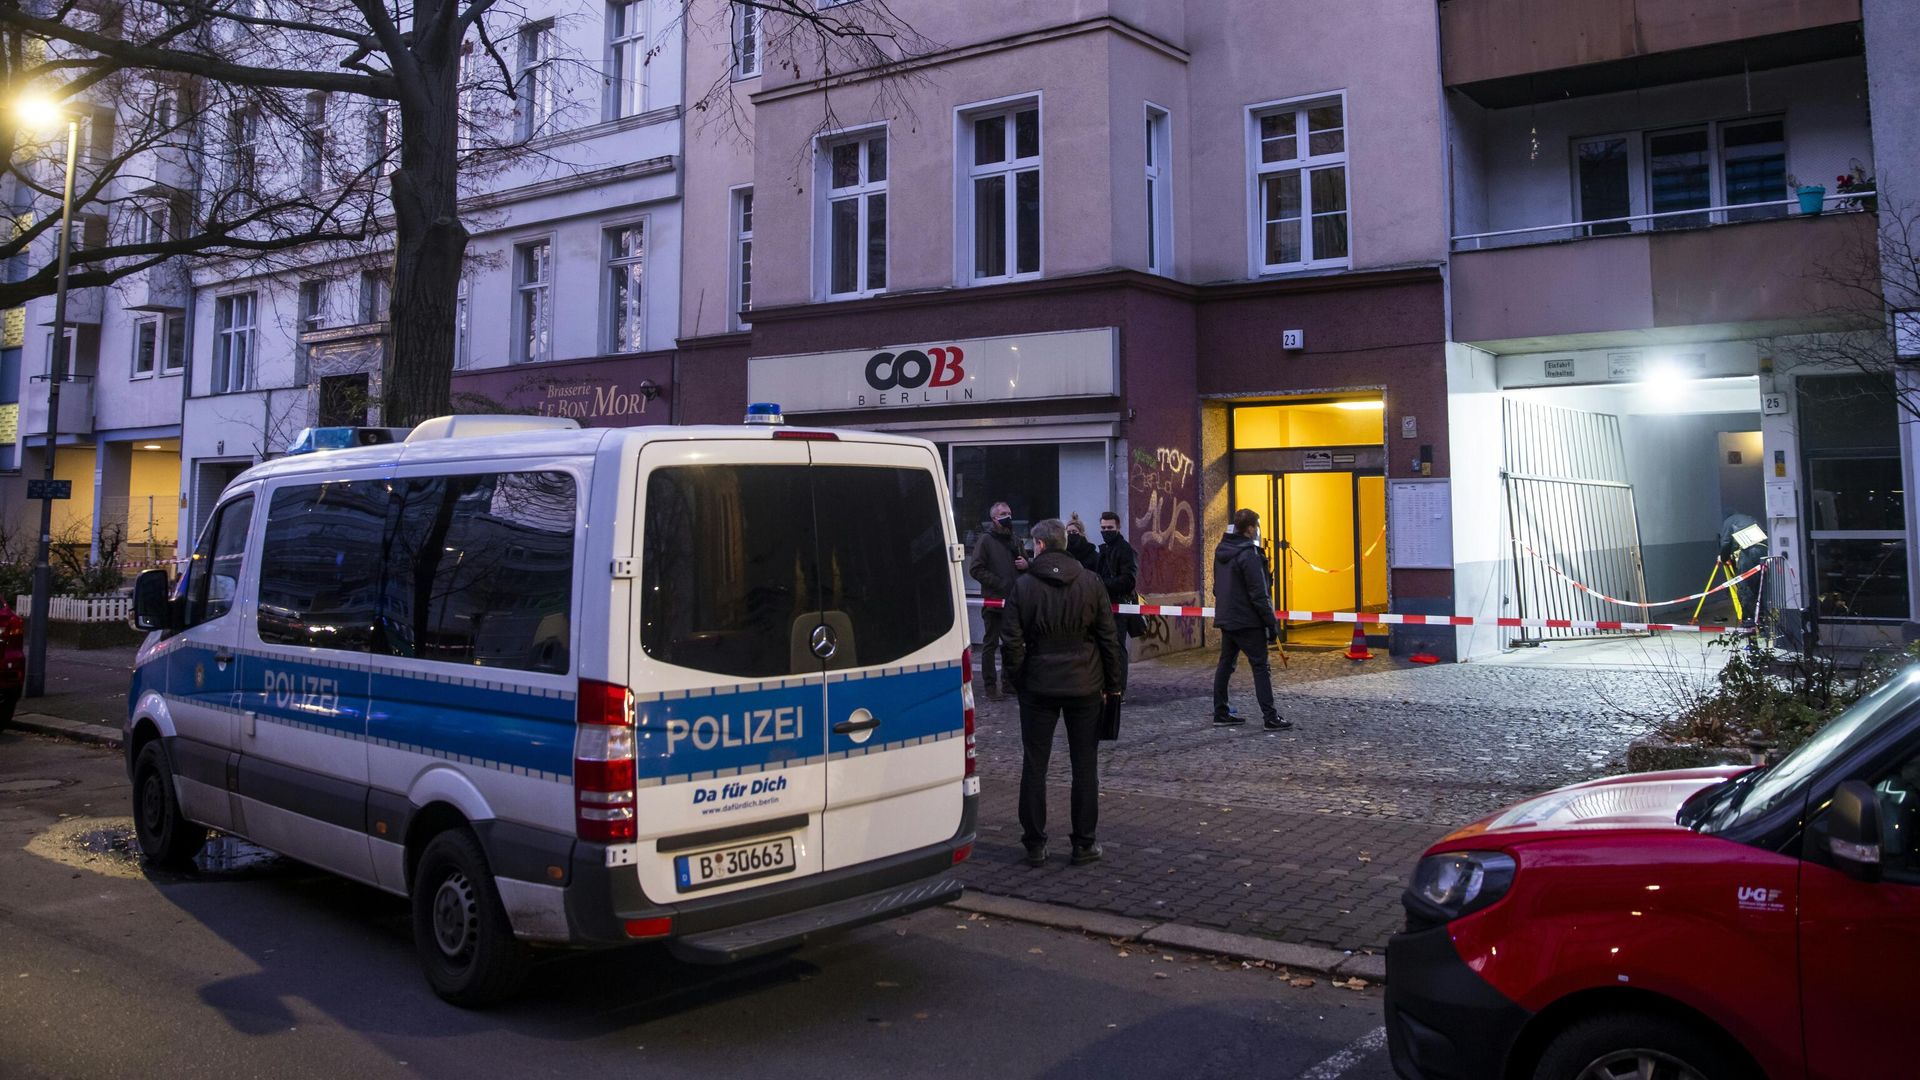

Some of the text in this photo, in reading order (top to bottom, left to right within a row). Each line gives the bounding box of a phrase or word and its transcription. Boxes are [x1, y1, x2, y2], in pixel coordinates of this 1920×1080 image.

[1284, 334, 1296, 346] 23
[547, 382, 592, 399] Brasserie
[558, 400, 589, 418] BON
[590, 385, 647, 418] MORI
[858, 388, 973, 406] BERLIN
[1766, 398, 1780, 409] 25
[264, 669, 338, 718] POLIZEI
[666, 705, 804, 754] POLIZEI
[693, 775, 787, 804] Da für Dich
[702, 797, 780, 815] www.dafürdich.berlin
[700, 843, 784, 879] B 30663
